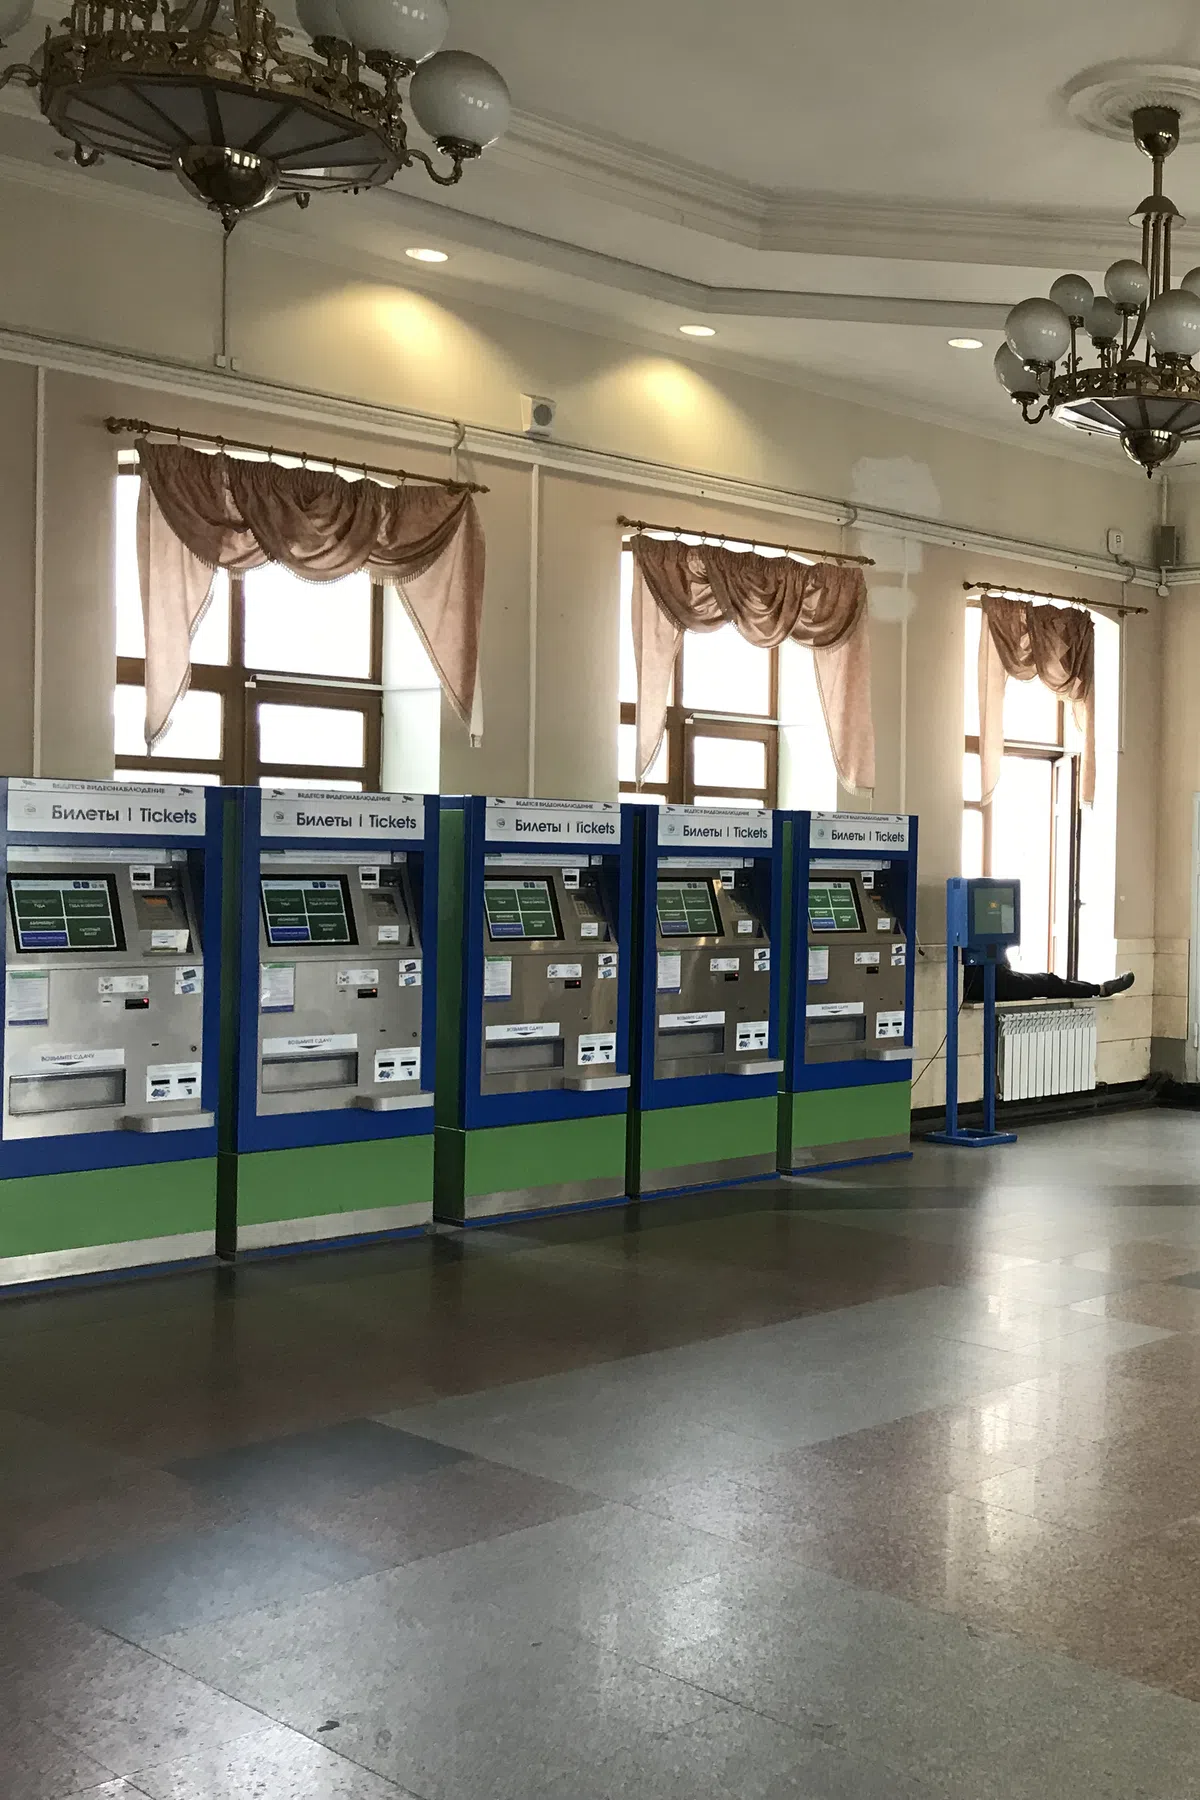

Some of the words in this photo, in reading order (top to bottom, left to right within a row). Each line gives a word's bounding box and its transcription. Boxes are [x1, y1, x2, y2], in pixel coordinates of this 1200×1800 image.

[326, 793, 391, 802] ВИДЕОНАБЛЮДЕНИЕ
[51, 804, 119, 822] Билеты
[139, 807, 197, 824] Tickets
[296, 812, 352, 827] Билеты
[369, 814, 417, 829] Tickets
[515, 818, 562, 833] Билеты
[576, 821, 616, 834] Tickets
[683, 825, 723, 837] Билеты
[733, 826, 768, 839] Tickets
[831, 829, 866, 841] Билеты
[875, 831, 905, 843] Tickets
